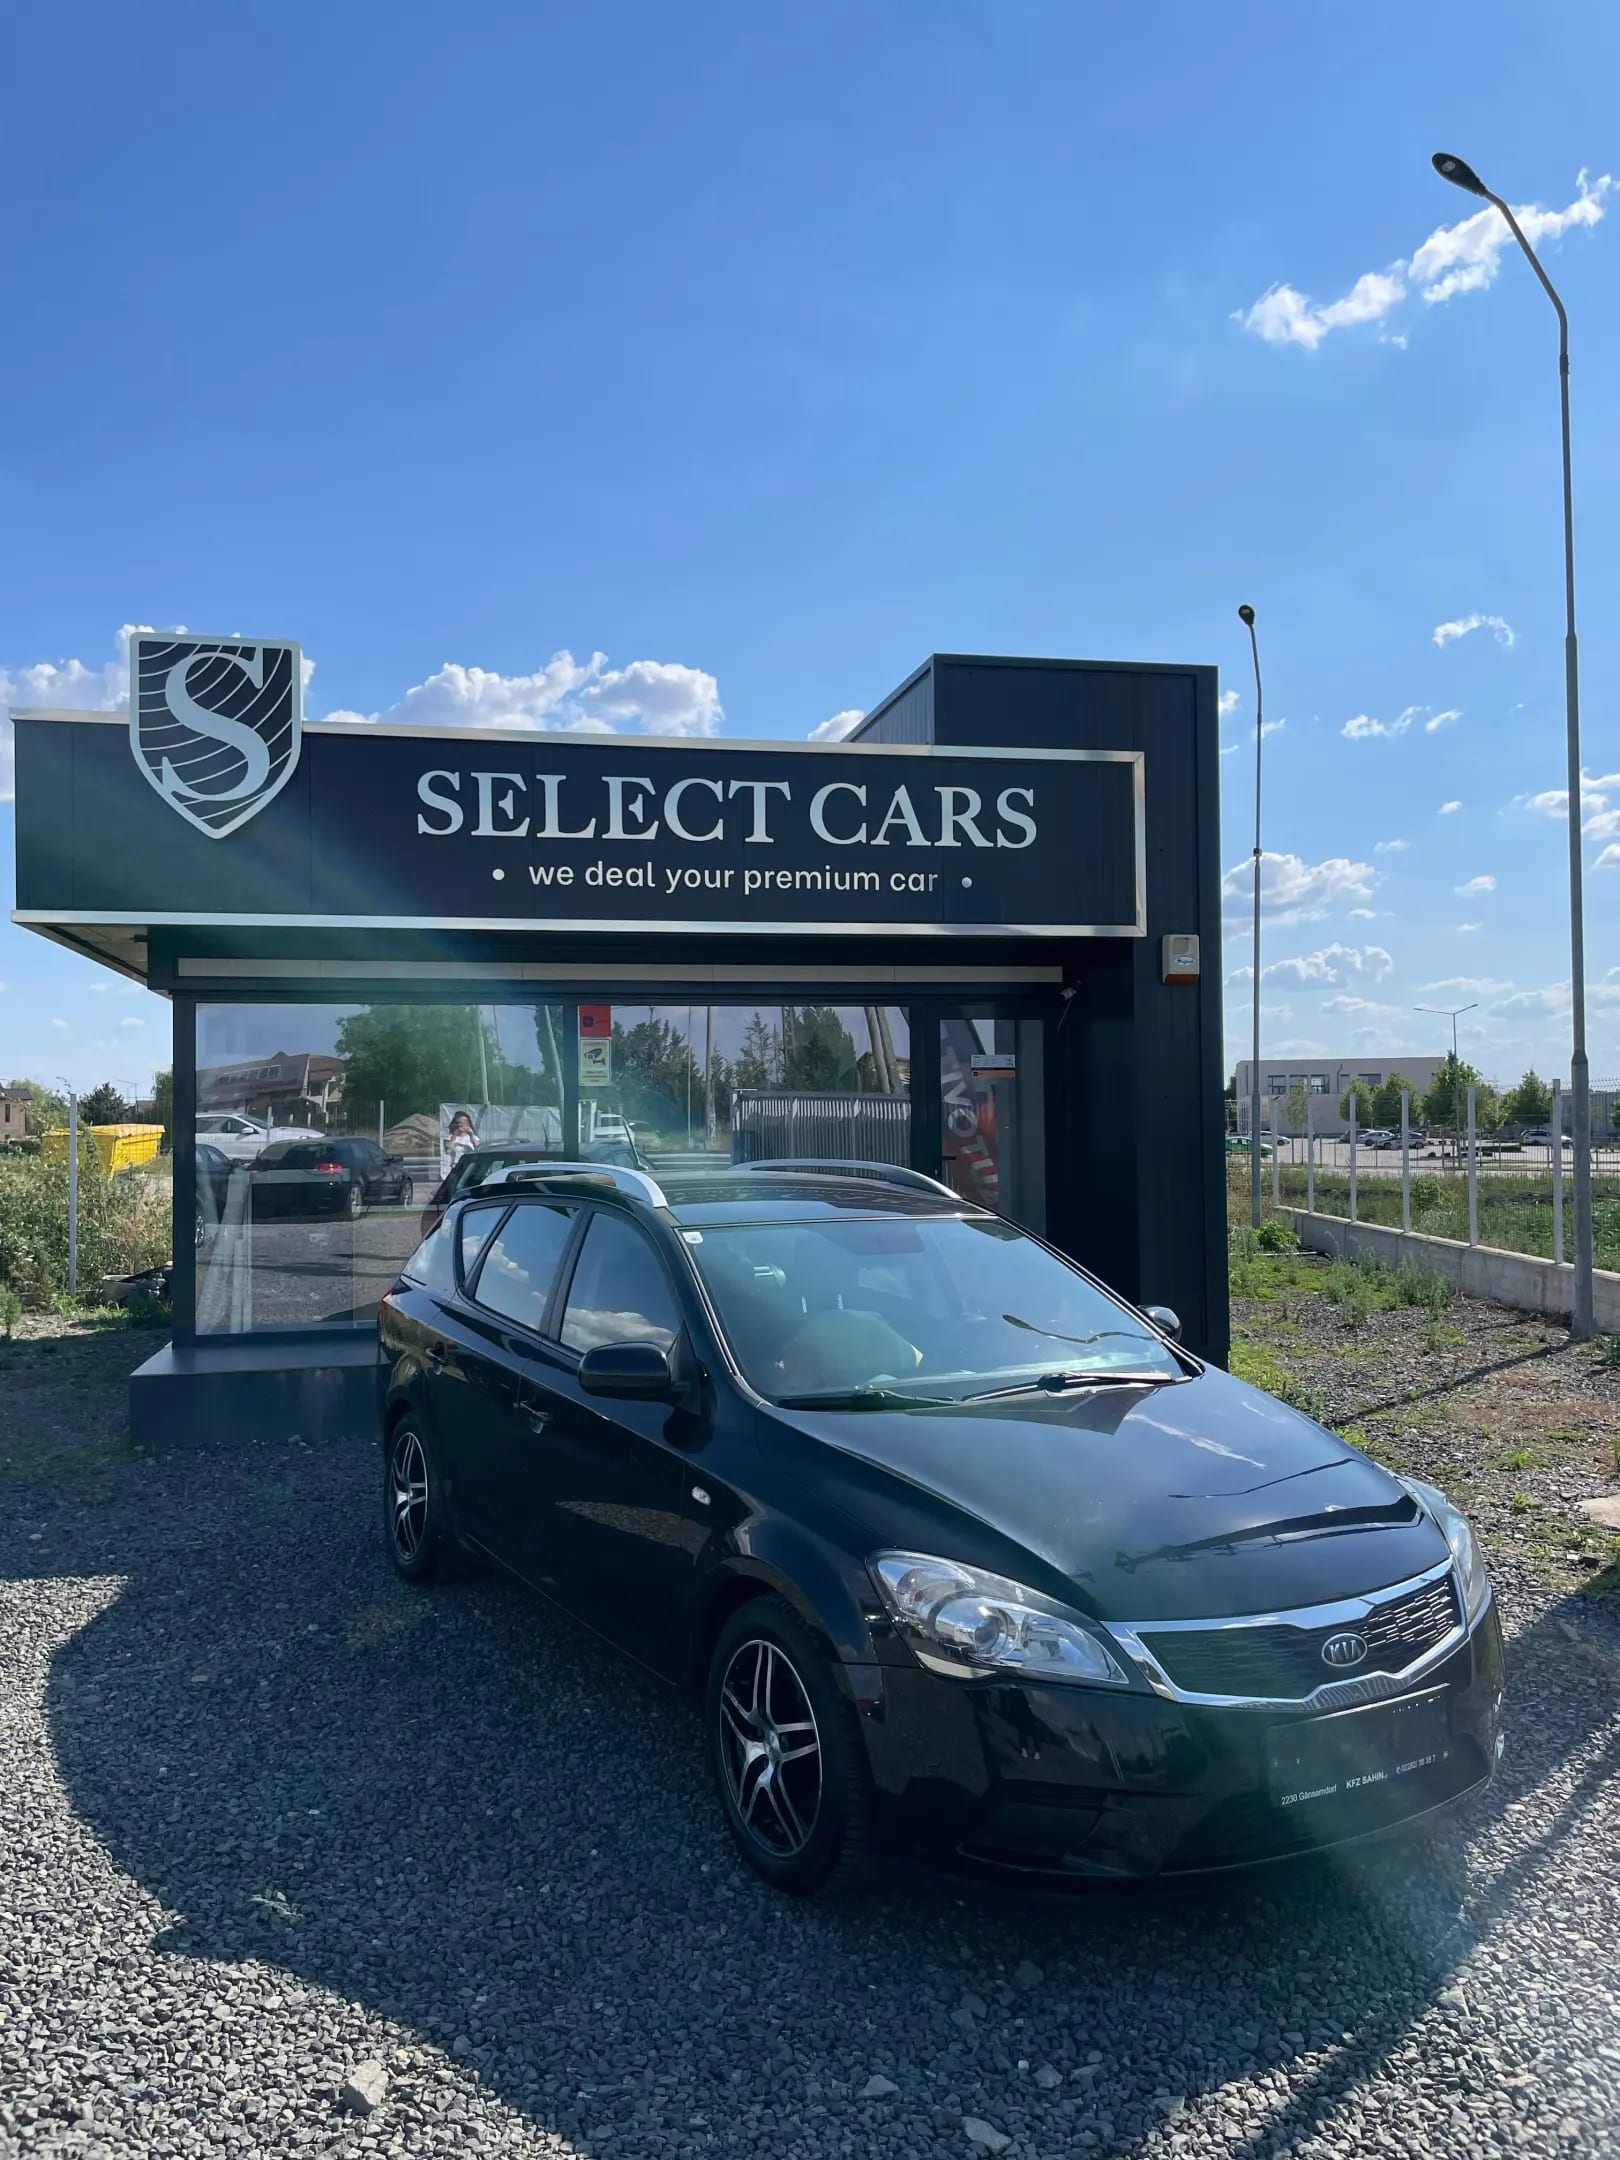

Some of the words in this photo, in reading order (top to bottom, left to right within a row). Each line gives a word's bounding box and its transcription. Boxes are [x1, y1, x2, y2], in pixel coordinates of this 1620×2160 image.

[417, 769, 792, 842] SELECT
[809, 782, 1037, 849] CARS
[529, 865, 575, 886] we
[584, 860, 656, 888] deal
[665, 867, 734, 894] your
[744, 864, 880, 896] premium
[889, 871, 938, 892] car
[1328, 1639, 1362, 1663] KIA
[1281, 1793, 1298, 1805] 2230
[1346, 1777, 1361, 1789] KFZ
